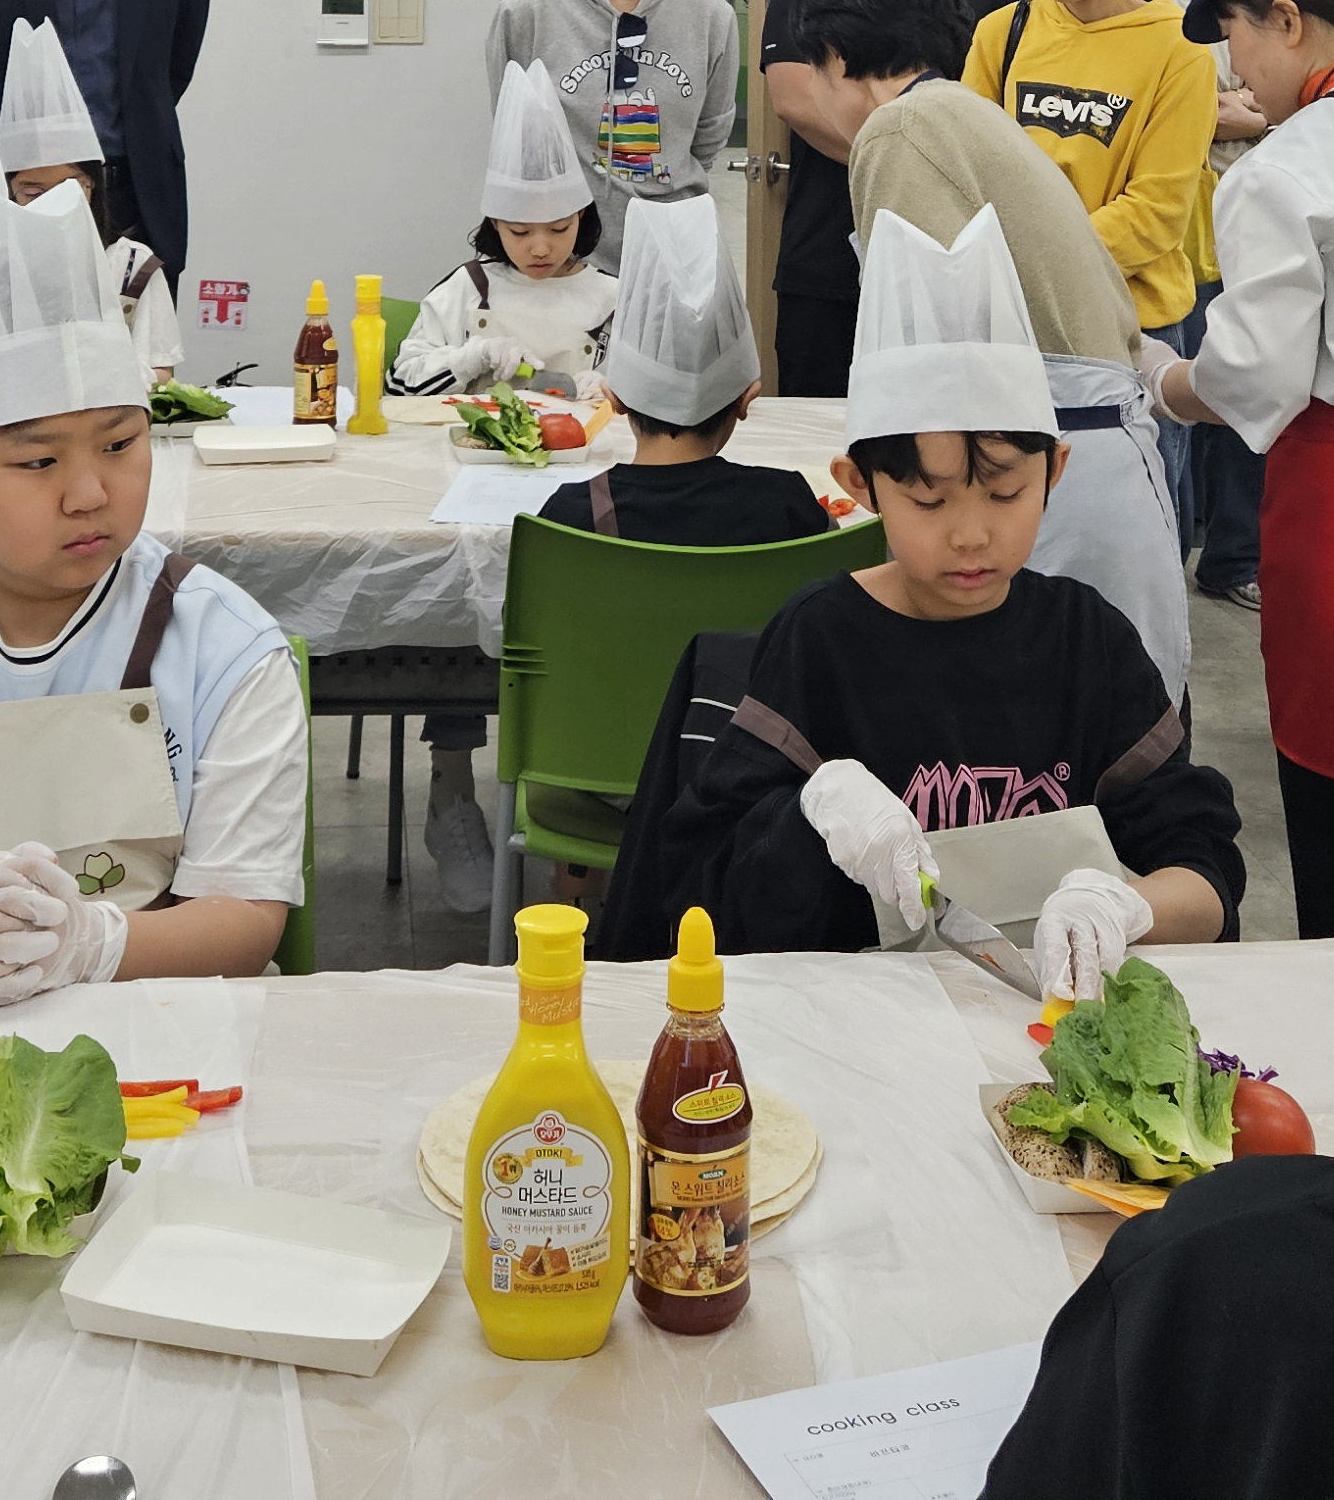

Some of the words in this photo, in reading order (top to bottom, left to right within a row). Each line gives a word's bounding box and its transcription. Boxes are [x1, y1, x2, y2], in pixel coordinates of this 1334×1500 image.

[655, 50, 693, 98] Love
[202, 282, 237, 296] 소화기
[534, 1169, 563, 1186] 허니
[519, 1187, 577, 1204] 머스타드
[502, 1205, 527, 1217] HONEY
[529, 1208, 566, 1218] MUSTARD
[568, 1205, 593, 1216] SAUCE
[806, 1411, 898, 1436] cooking
[905, 1396, 960, 1417] class
